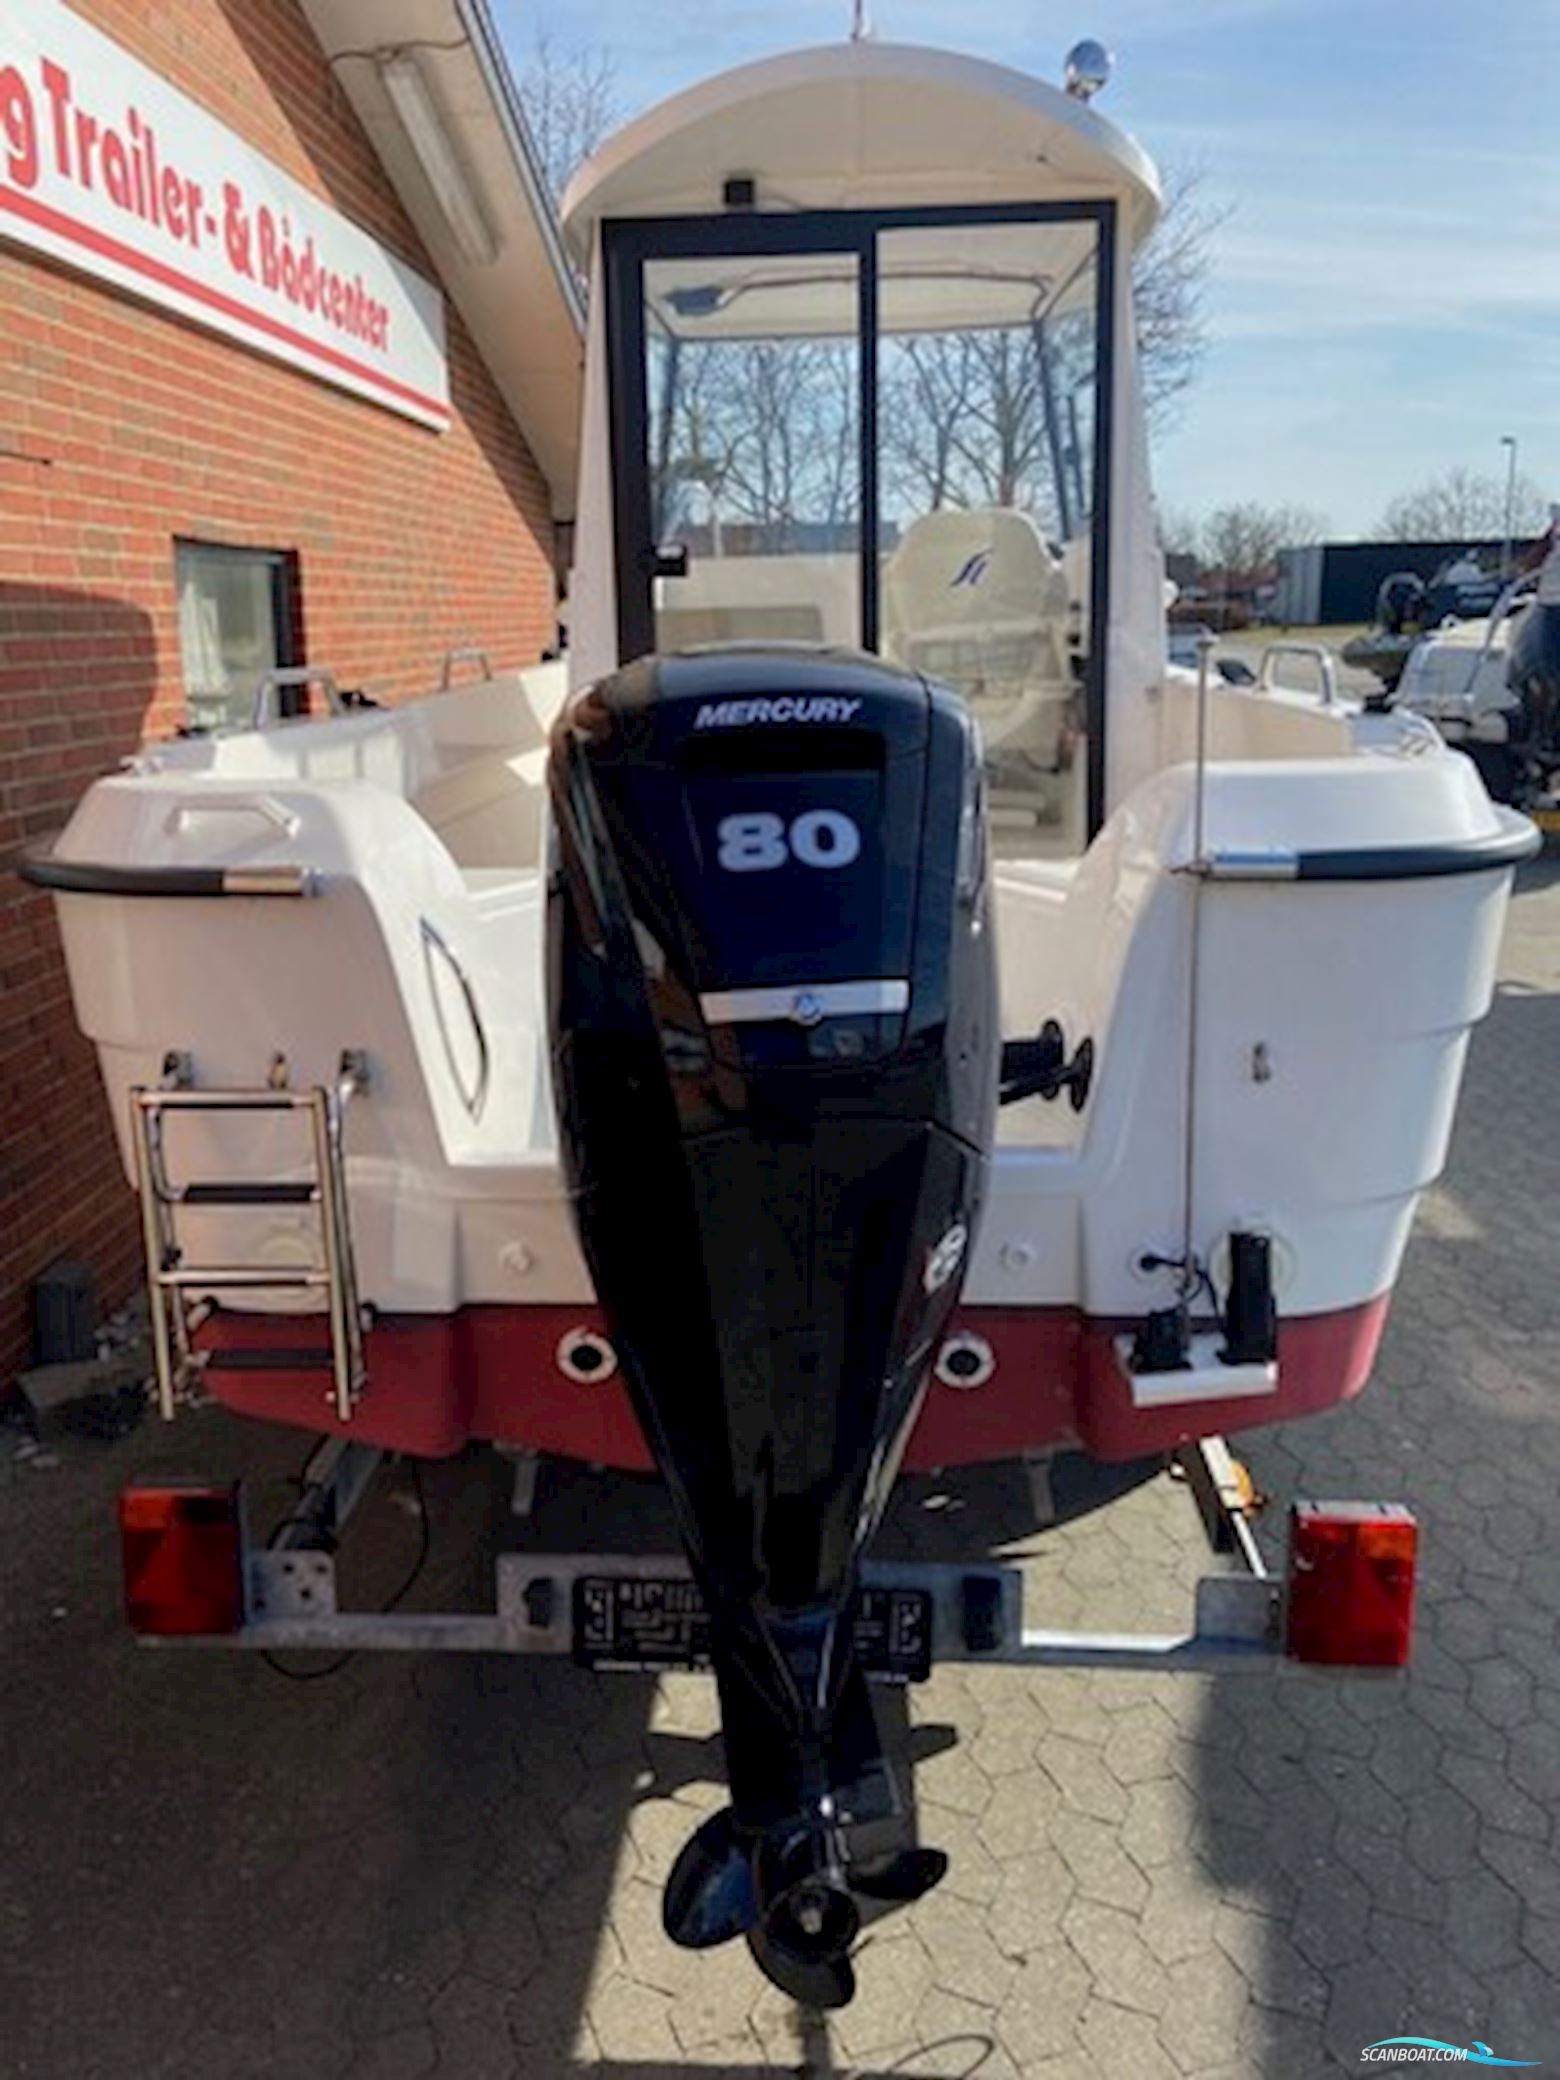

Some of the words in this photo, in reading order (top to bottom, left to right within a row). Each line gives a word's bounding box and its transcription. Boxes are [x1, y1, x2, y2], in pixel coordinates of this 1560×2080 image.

[42, 57, 216, 248] Trailer-
[223, 182, 255, 281] &
[259, 205, 389, 352] Bådcenter
[694, 697, 862, 730] MERCURY
[717, 809, 861, 872] 80
